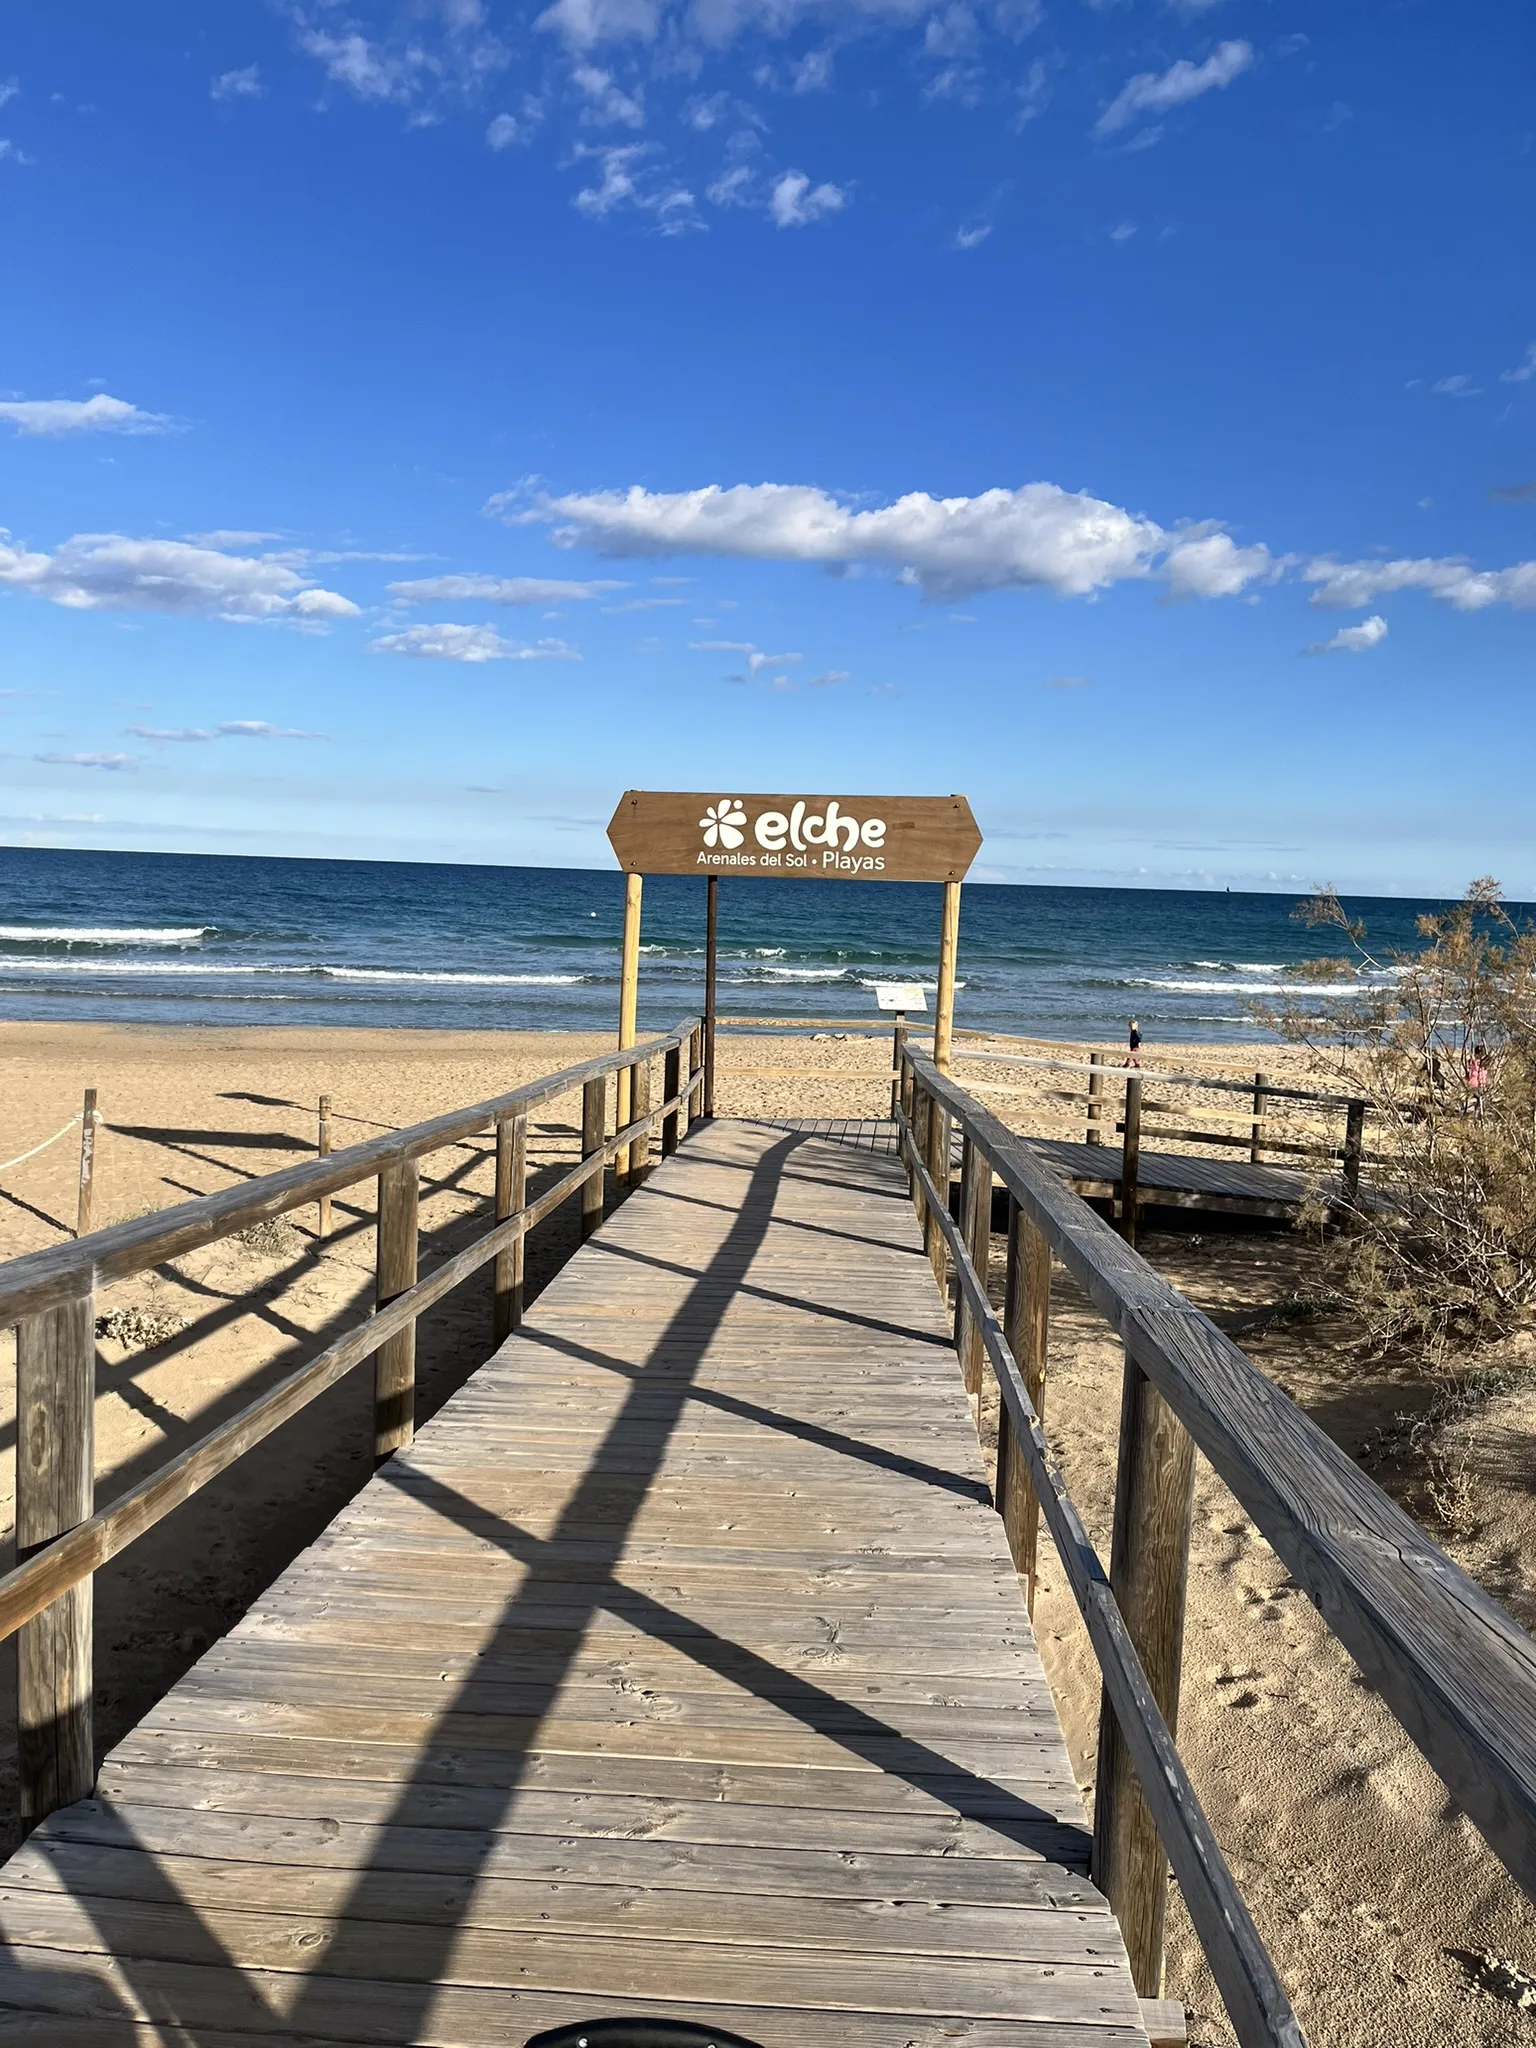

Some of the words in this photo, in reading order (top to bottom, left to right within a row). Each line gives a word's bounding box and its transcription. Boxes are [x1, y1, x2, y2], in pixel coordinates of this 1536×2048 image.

[754, 800, 887, 852] elche
[696, 851, 757, 866] Arenales
[759, 852, 782, 867] del
[785, 853, 808, 868] Sol
[822, 850, 886, 875] Playas
